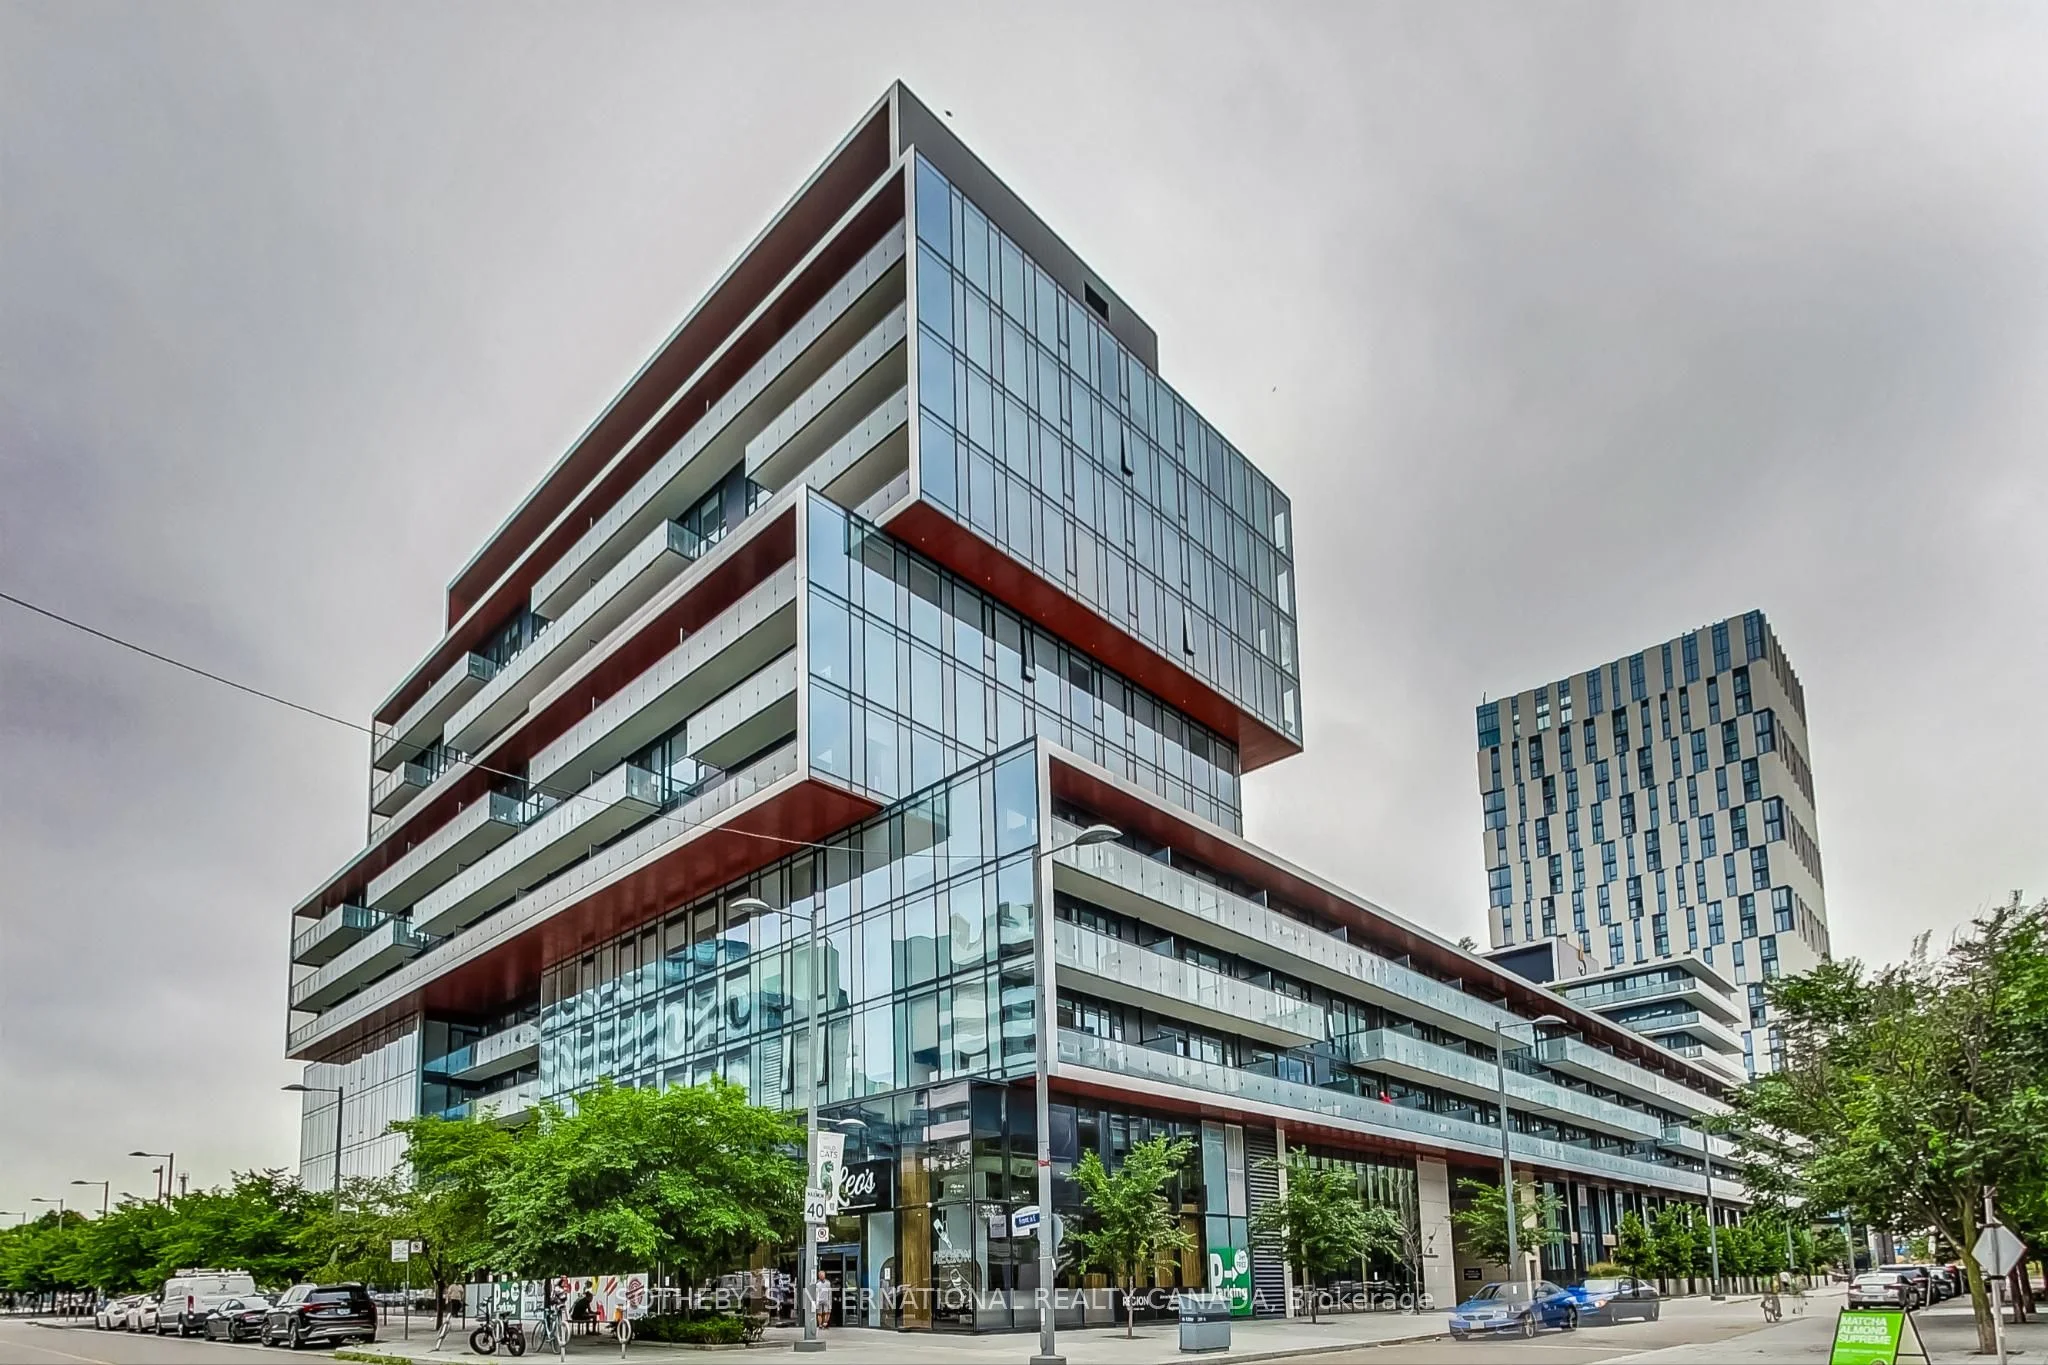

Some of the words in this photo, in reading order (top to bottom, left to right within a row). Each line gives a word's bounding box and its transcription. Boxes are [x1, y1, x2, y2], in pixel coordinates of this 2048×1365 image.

[838, 1166, 876, 1207] Leo's
[807, 1203, 824, 1218] 40
[1209, 1253, 1248, 1301] Parking
[1122, 1296, 1149, 1307] REGION
[1841, 1316, 1887, 1326] MATCHA
[1839, 1326, 1887, 1335] ALMOND
[1837, 1335, 1891, 1344] SUPREME
